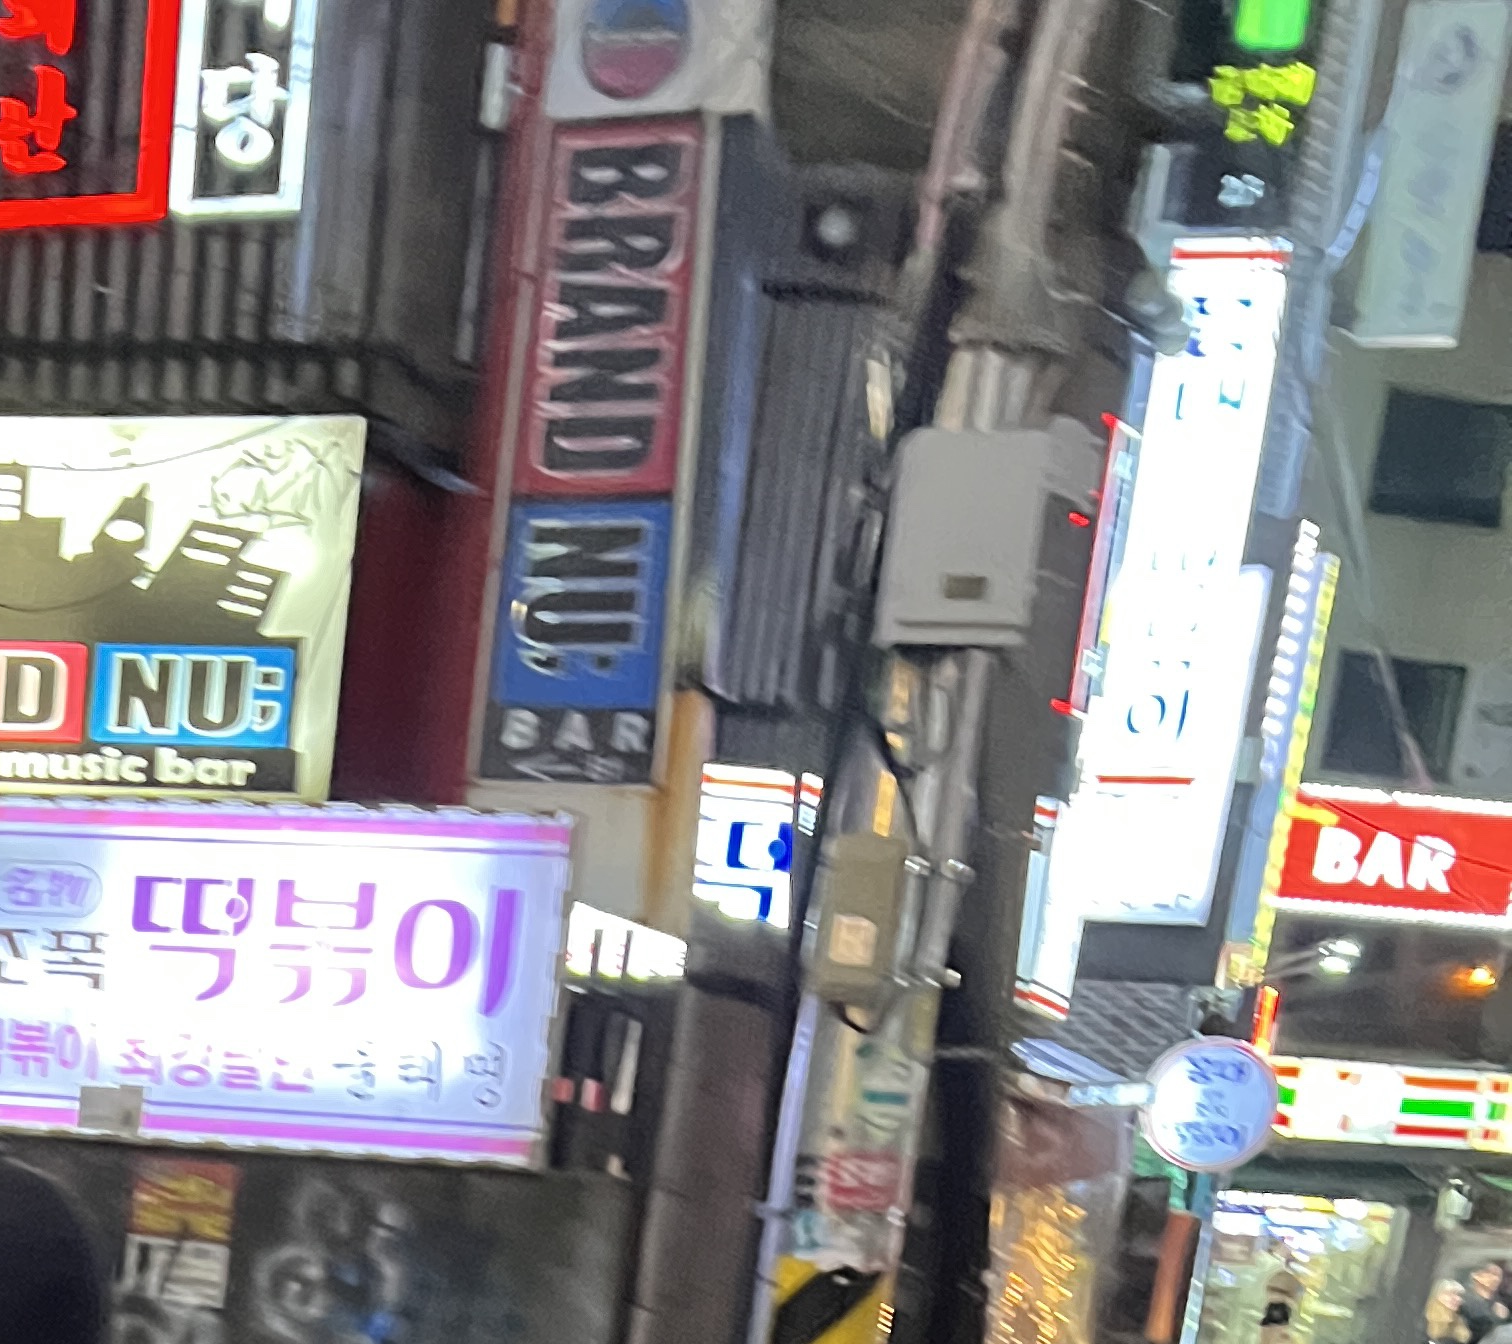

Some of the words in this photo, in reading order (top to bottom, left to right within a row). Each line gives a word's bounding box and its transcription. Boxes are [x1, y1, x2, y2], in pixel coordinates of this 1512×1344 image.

[534, 142, 691, 478] BRAND
[501, 709, 649, 753] BAR
[153, 747, 257, 786] bar
[1312, 825, 1457, 894] BAR
[131, 875, 526, 1018] 떡볶이
